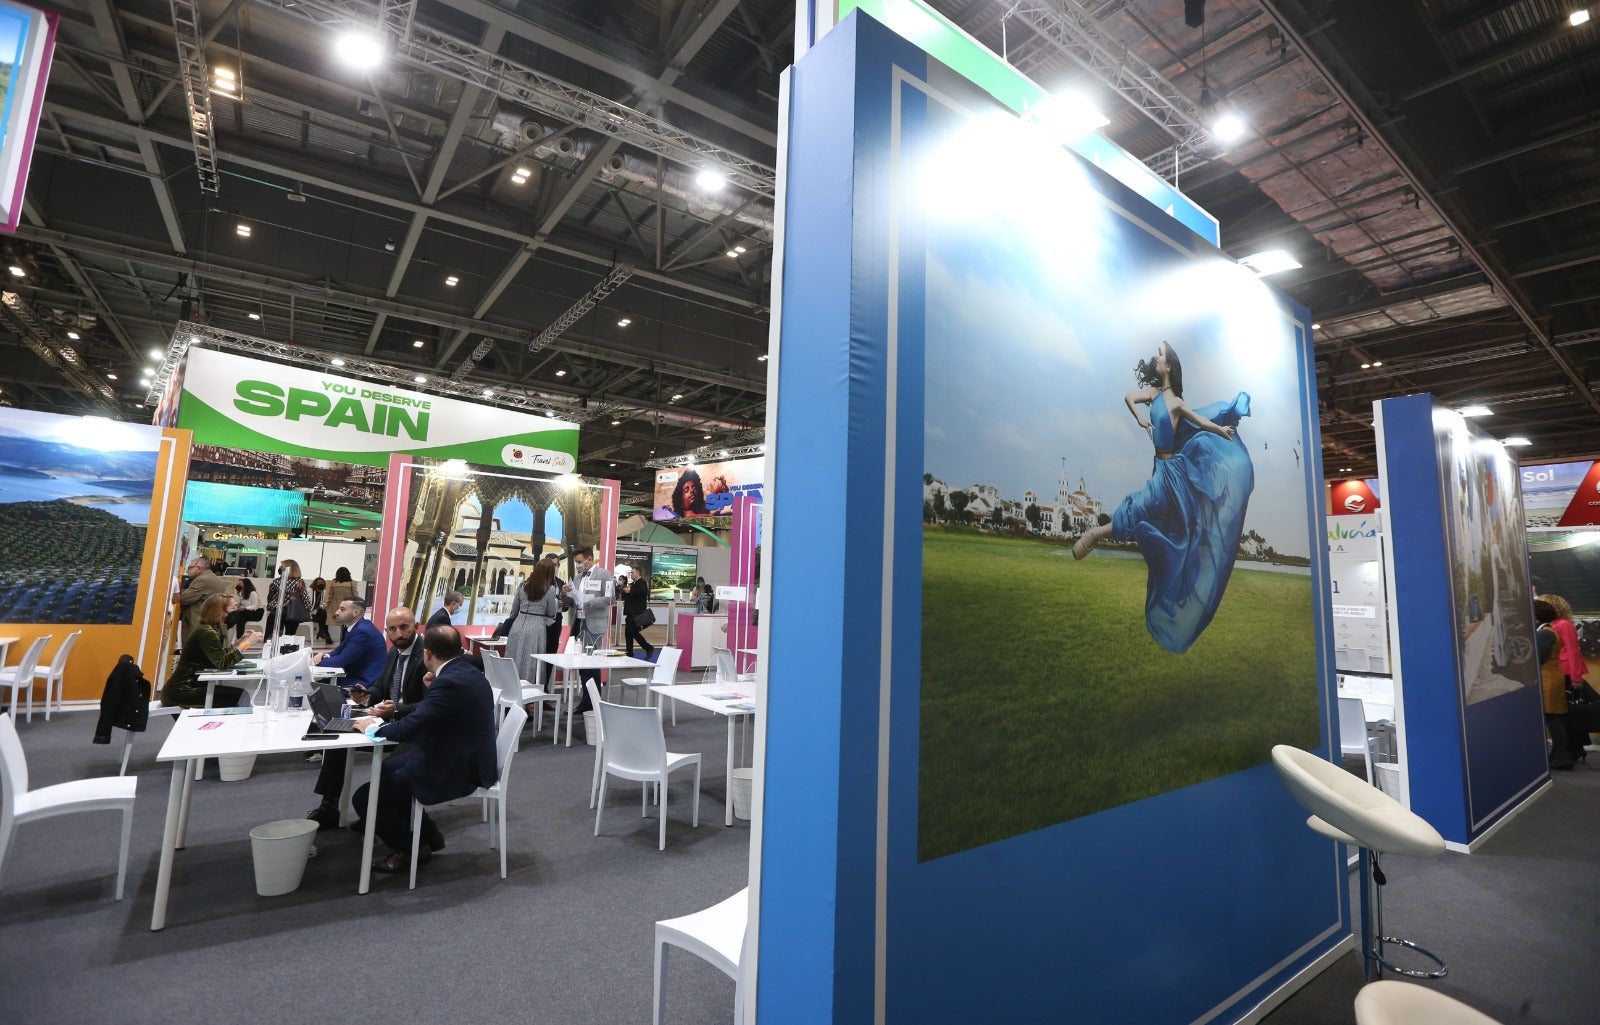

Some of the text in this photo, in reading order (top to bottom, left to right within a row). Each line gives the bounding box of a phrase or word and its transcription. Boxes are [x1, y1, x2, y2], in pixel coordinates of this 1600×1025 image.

[322, 381, 431, 410] YOU DESERVE
[233, 380, 430, 441] SPAIN
[1523, 469, 1554, 482] Sol
